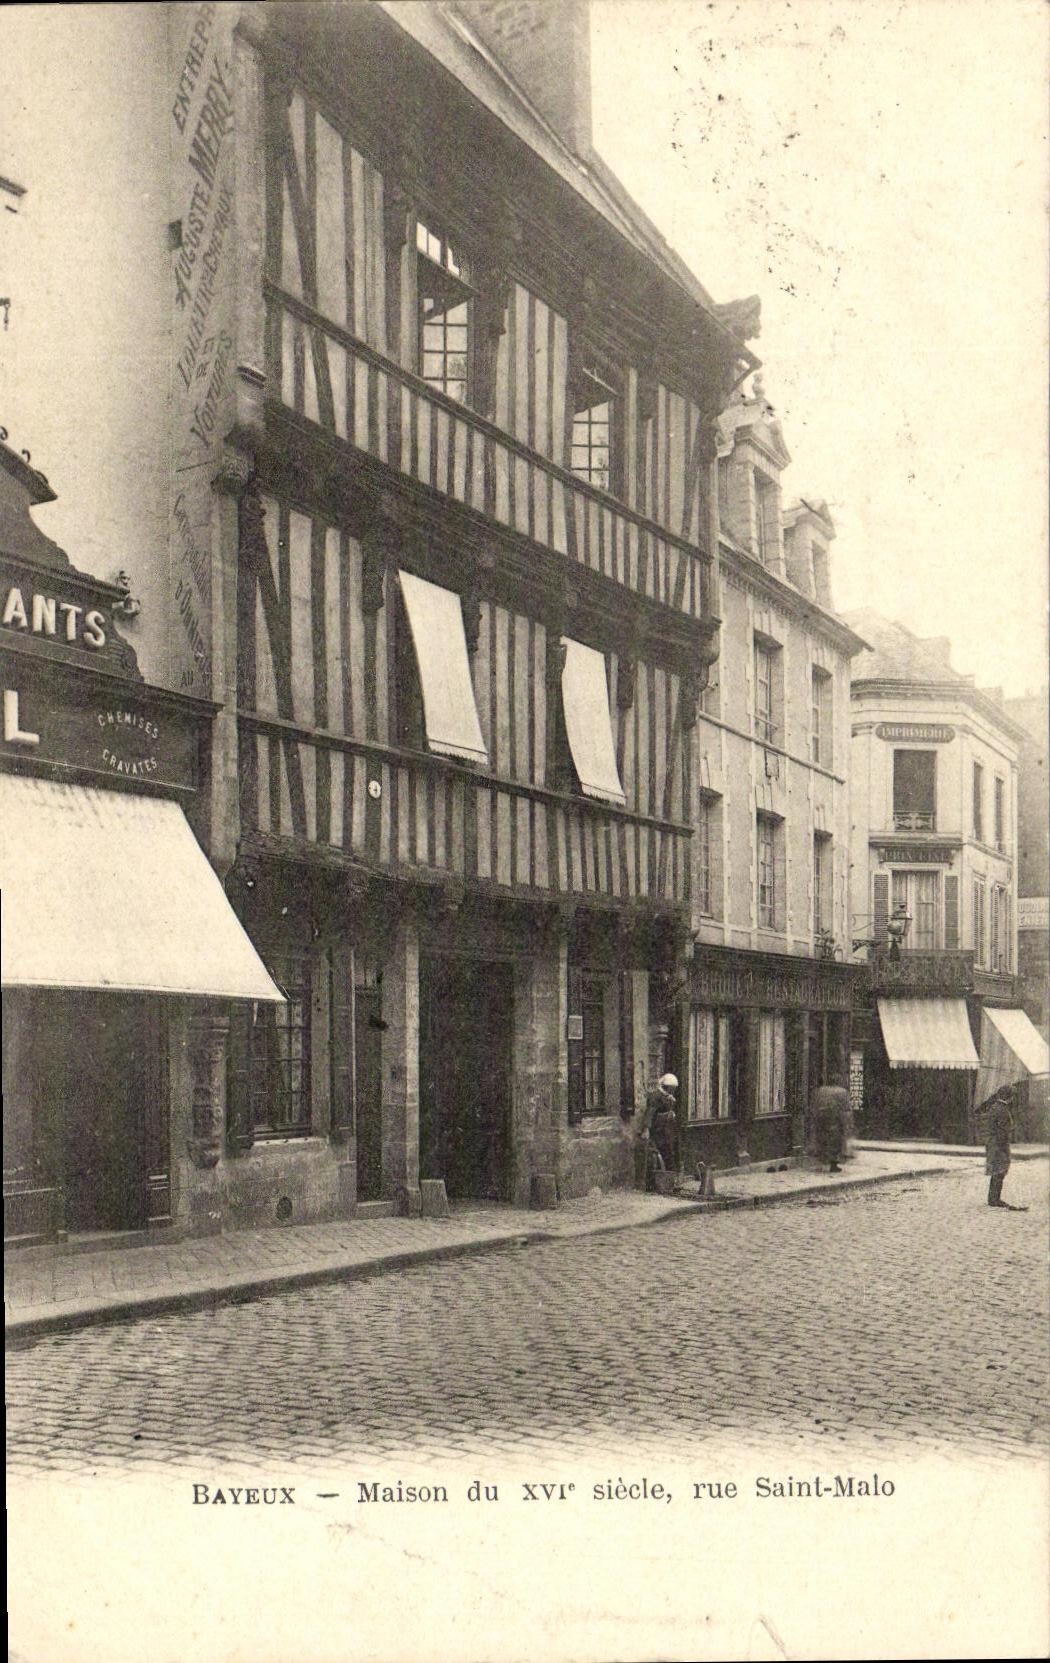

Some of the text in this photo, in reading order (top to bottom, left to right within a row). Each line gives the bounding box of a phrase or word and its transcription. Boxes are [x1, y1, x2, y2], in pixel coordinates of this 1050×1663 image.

[175, 182, 209, 311] AUGUSTE
[190, 329, 232, 448] VOITURES
[3, 689, 40, 744] L
[98, 711, 159, 739] CHEMISES
[881, 726, 949, 739] IMPRIMERIE
[102, 748, 157, 775] CRAVATES
